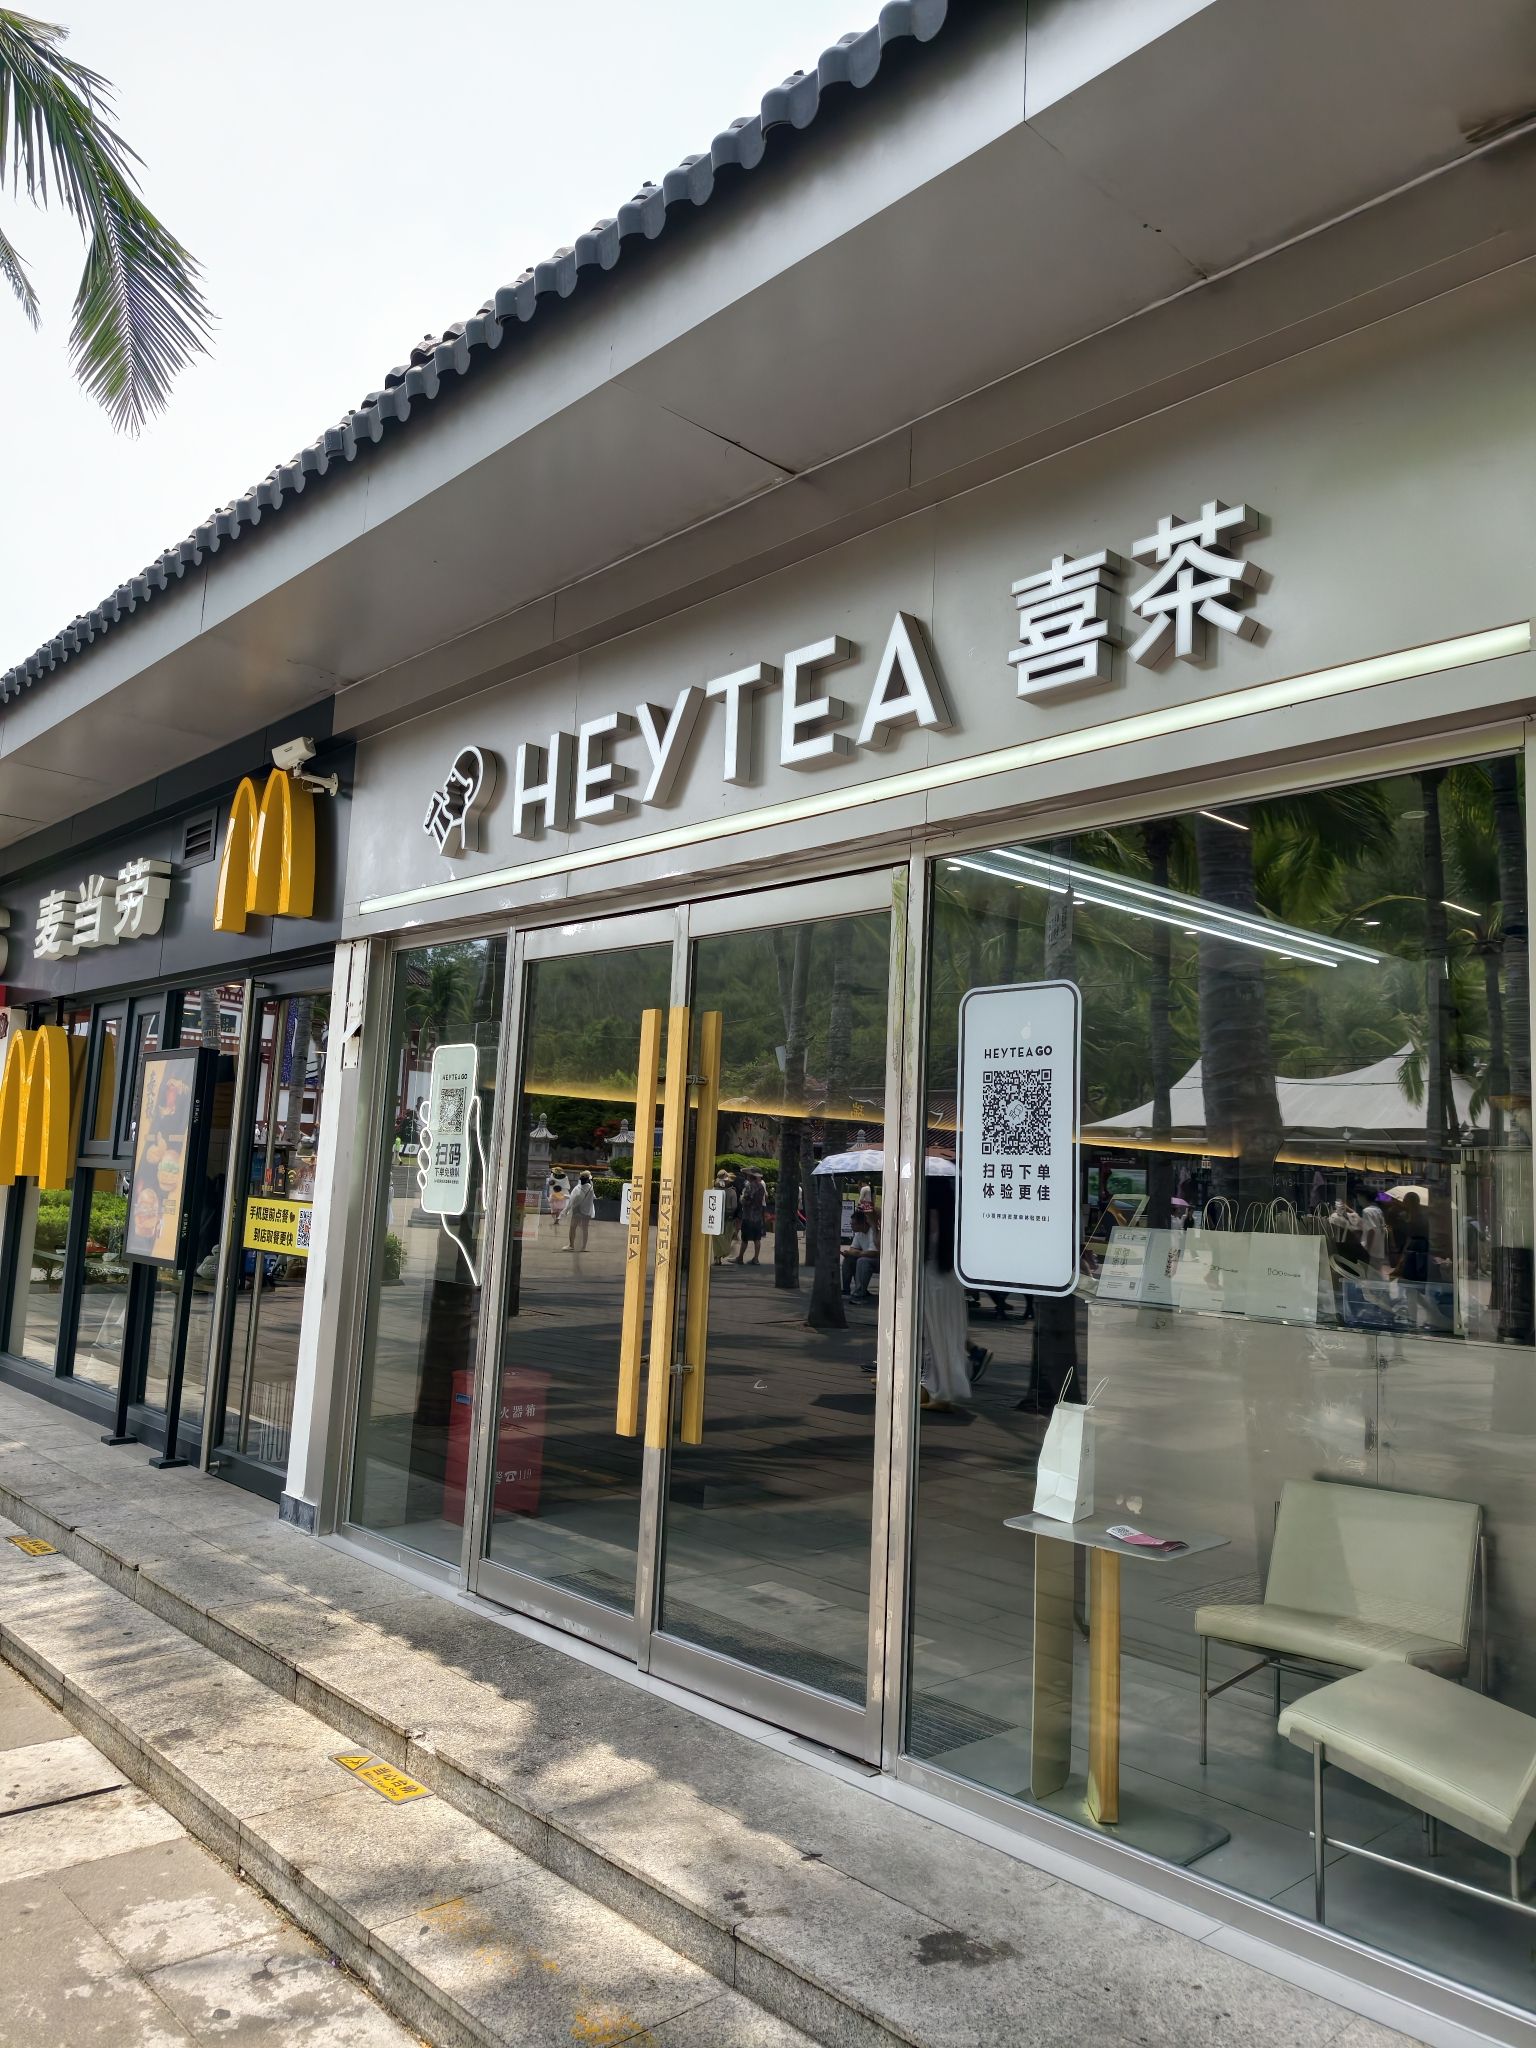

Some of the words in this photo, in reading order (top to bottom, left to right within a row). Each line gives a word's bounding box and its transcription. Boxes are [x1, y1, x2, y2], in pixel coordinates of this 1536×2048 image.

[513, 611, 950, 838] HEYTEA
[1008, 499, 1259, 701] 喜茶
[33, 857, 172, 960] 麦当劳
[435, 1141, 461, 1166] 扫码
[983, 1162, 1051, 1180] 扫码下单
[982, 1182, 1051, 1201] 体验更佳
[250, 1205, 289, 1223] 手机提前点餐
[628, 1175, 644, 1260] HEYTEA
[657, 1178, 674, 1266] HEYTEA
[253, 1227, 294, 1247] 到店取餐更快
